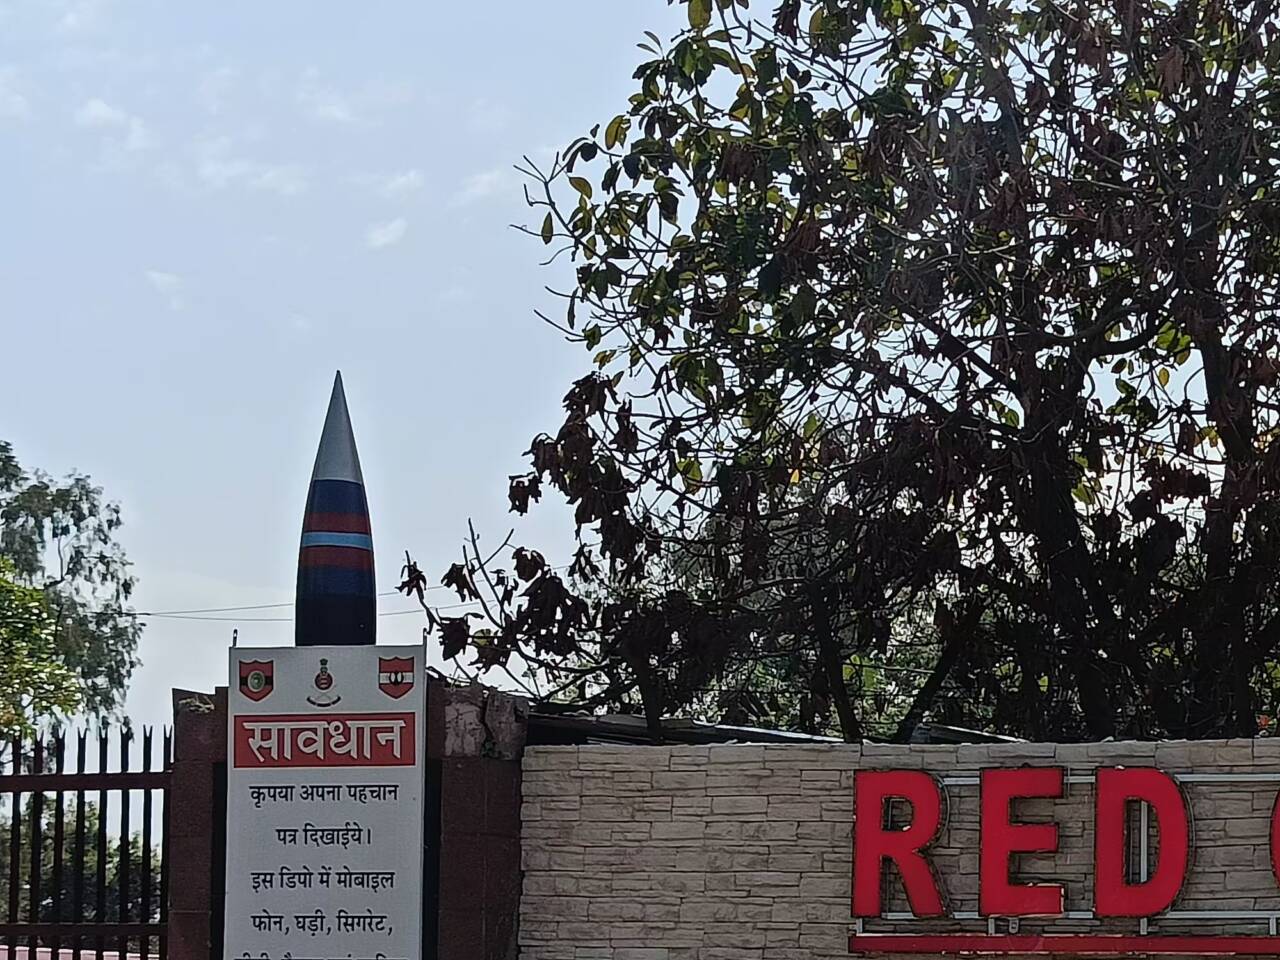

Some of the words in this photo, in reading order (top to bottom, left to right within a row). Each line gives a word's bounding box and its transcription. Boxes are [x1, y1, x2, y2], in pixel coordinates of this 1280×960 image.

[242, 719, 406, 763] सावधान
[249, 784, 295, 808] कृपया
[299, 784, 343, 802] अपना
[346, 784, 399, 804] पहचान
[276, 828, 298, 846] पत्र
[850, 764, 1191, 919] RED
[250, 871, 275, 893] इस
[278, 865, 314, 889] डिपो
[317, 865, 332, 889] में
[335, 865, 395, 893] मोबाइल
[250, 908, 290, 936] फोन,
[294, 908, 332, 937] घड़ी,
[336, 908, 394, 936] सिगरेट,
